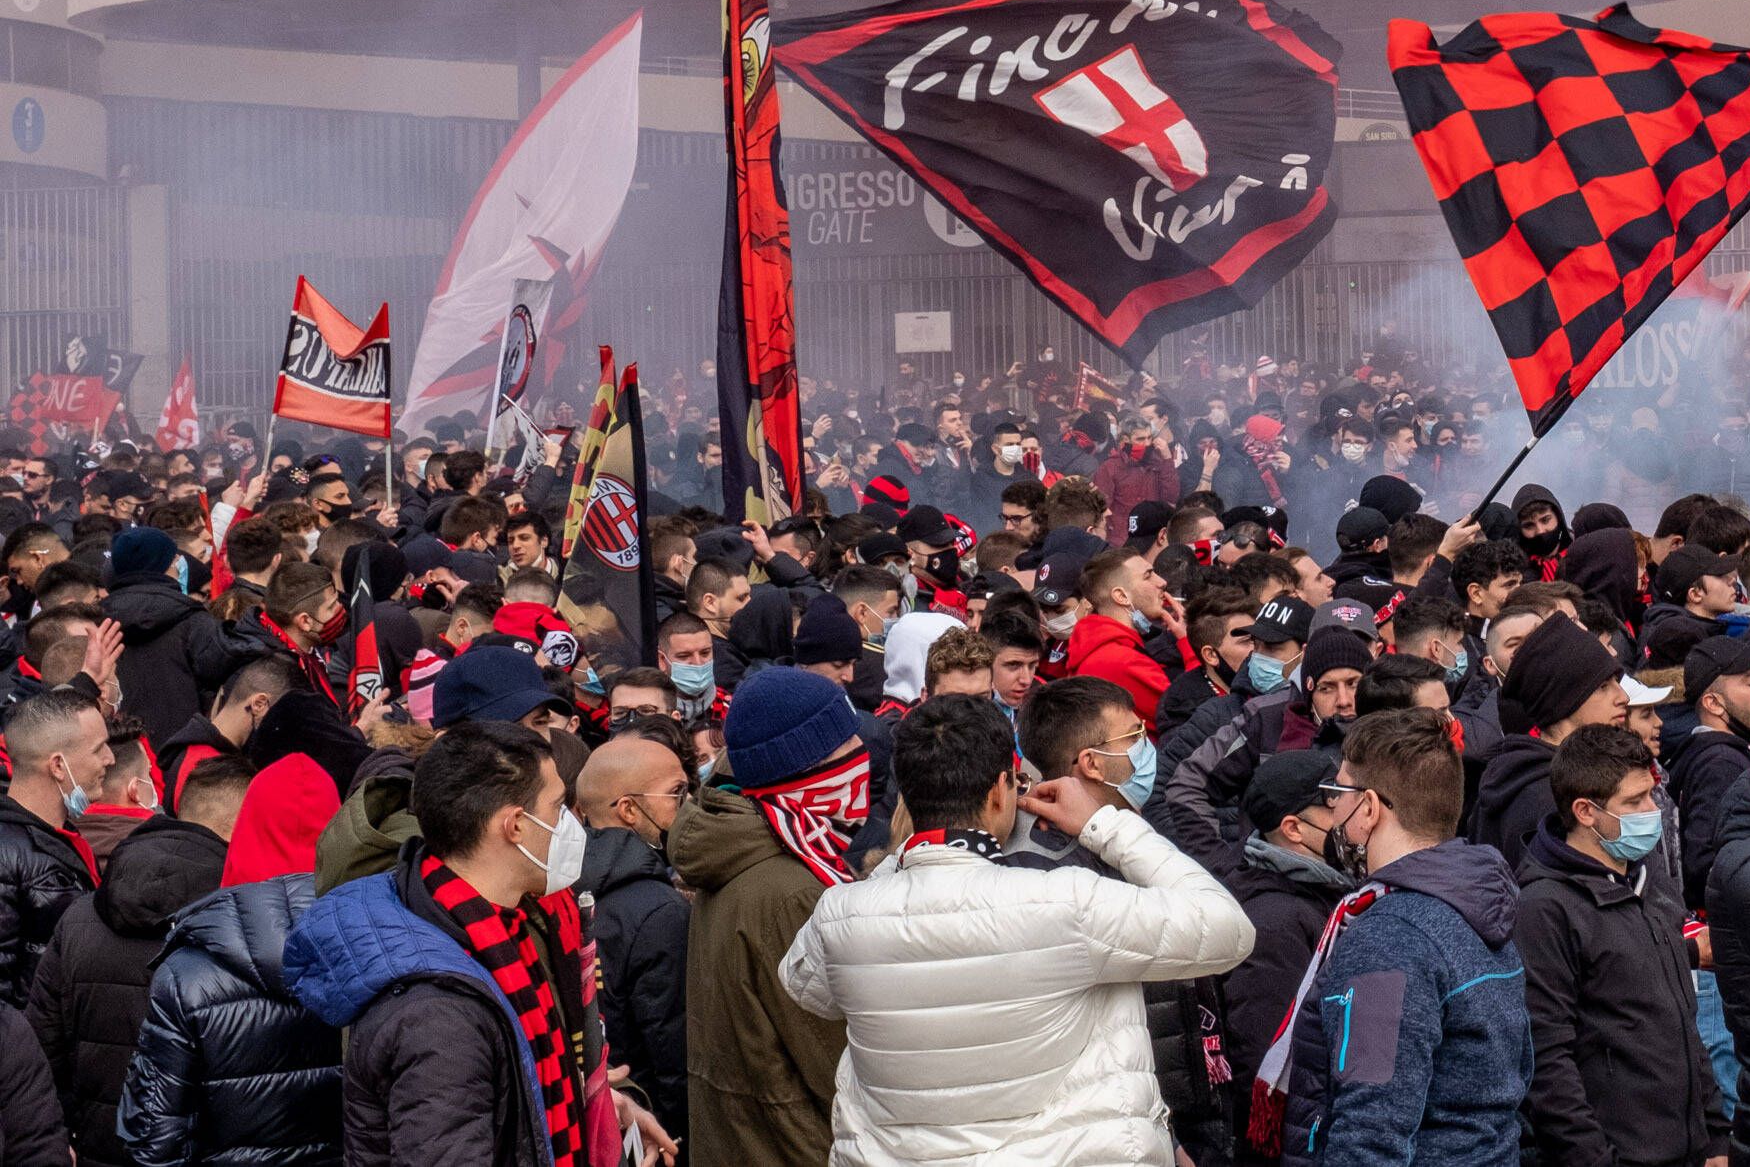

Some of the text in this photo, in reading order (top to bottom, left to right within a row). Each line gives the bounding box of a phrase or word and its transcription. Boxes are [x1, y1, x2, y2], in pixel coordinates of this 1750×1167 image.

[786, 170, 915, 211] GRESSO
[807, 209, 876, 245] GATE
[617, 544, 640, 564] 189
